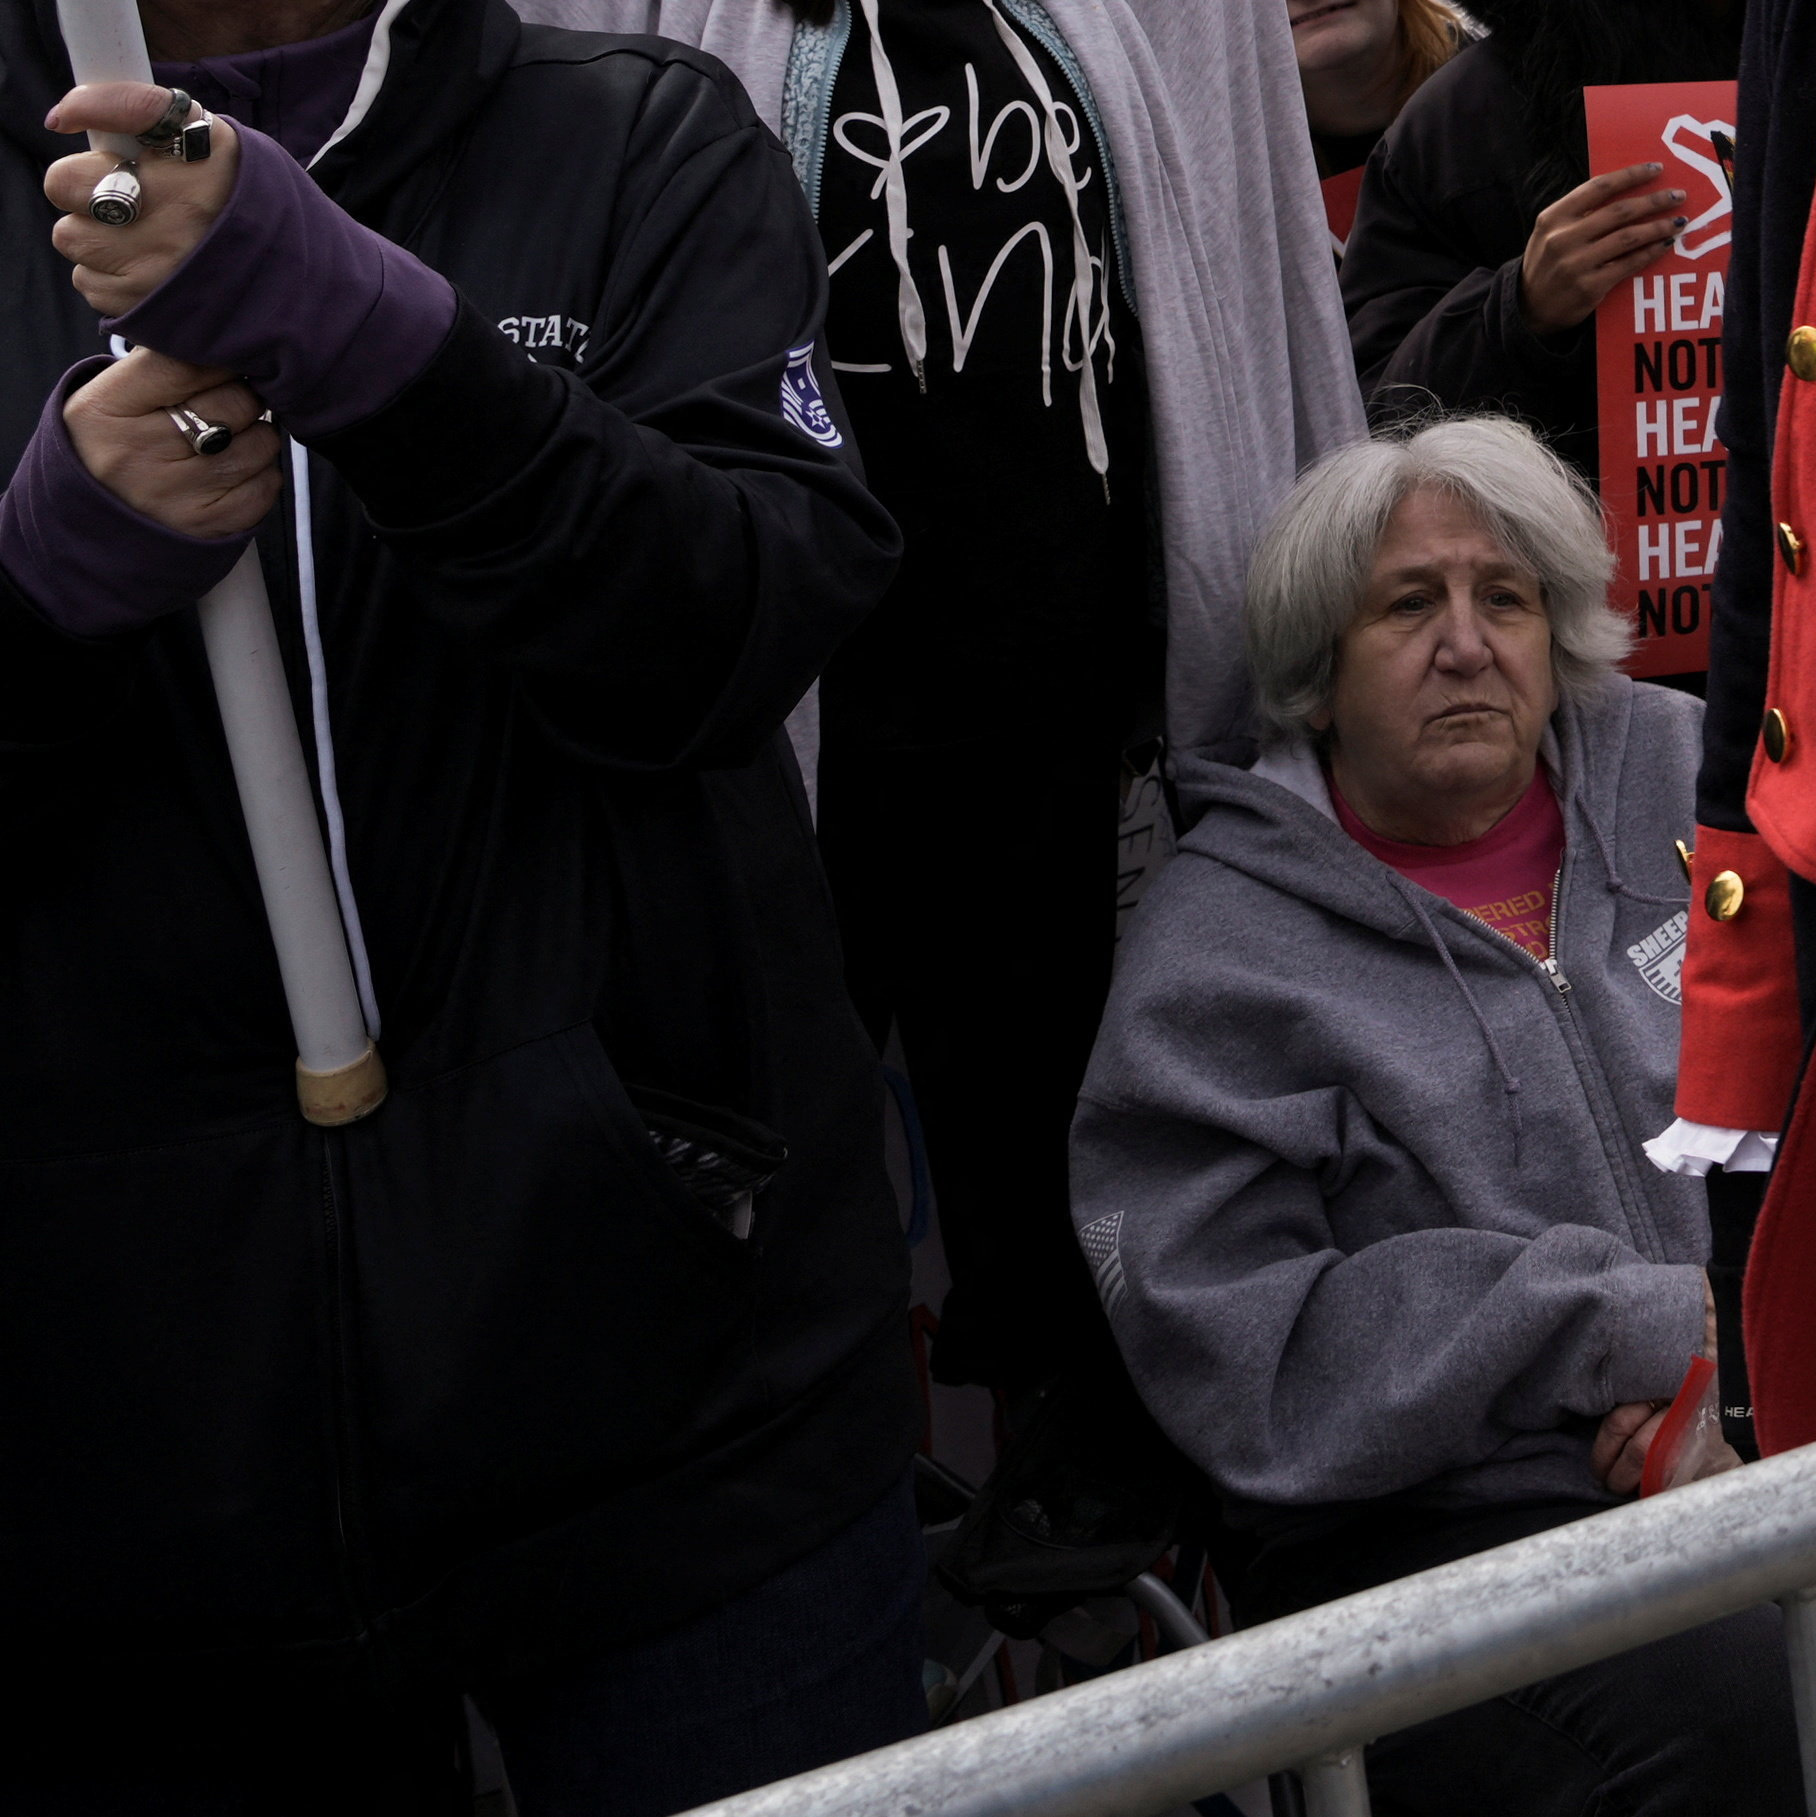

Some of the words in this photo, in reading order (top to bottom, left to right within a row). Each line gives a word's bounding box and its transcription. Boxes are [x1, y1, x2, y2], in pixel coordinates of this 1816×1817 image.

[967, 62, 1092, 193] be
[1634, 337, 1722, 394] NOT
[1637, 460, 1727, 518] NOT
